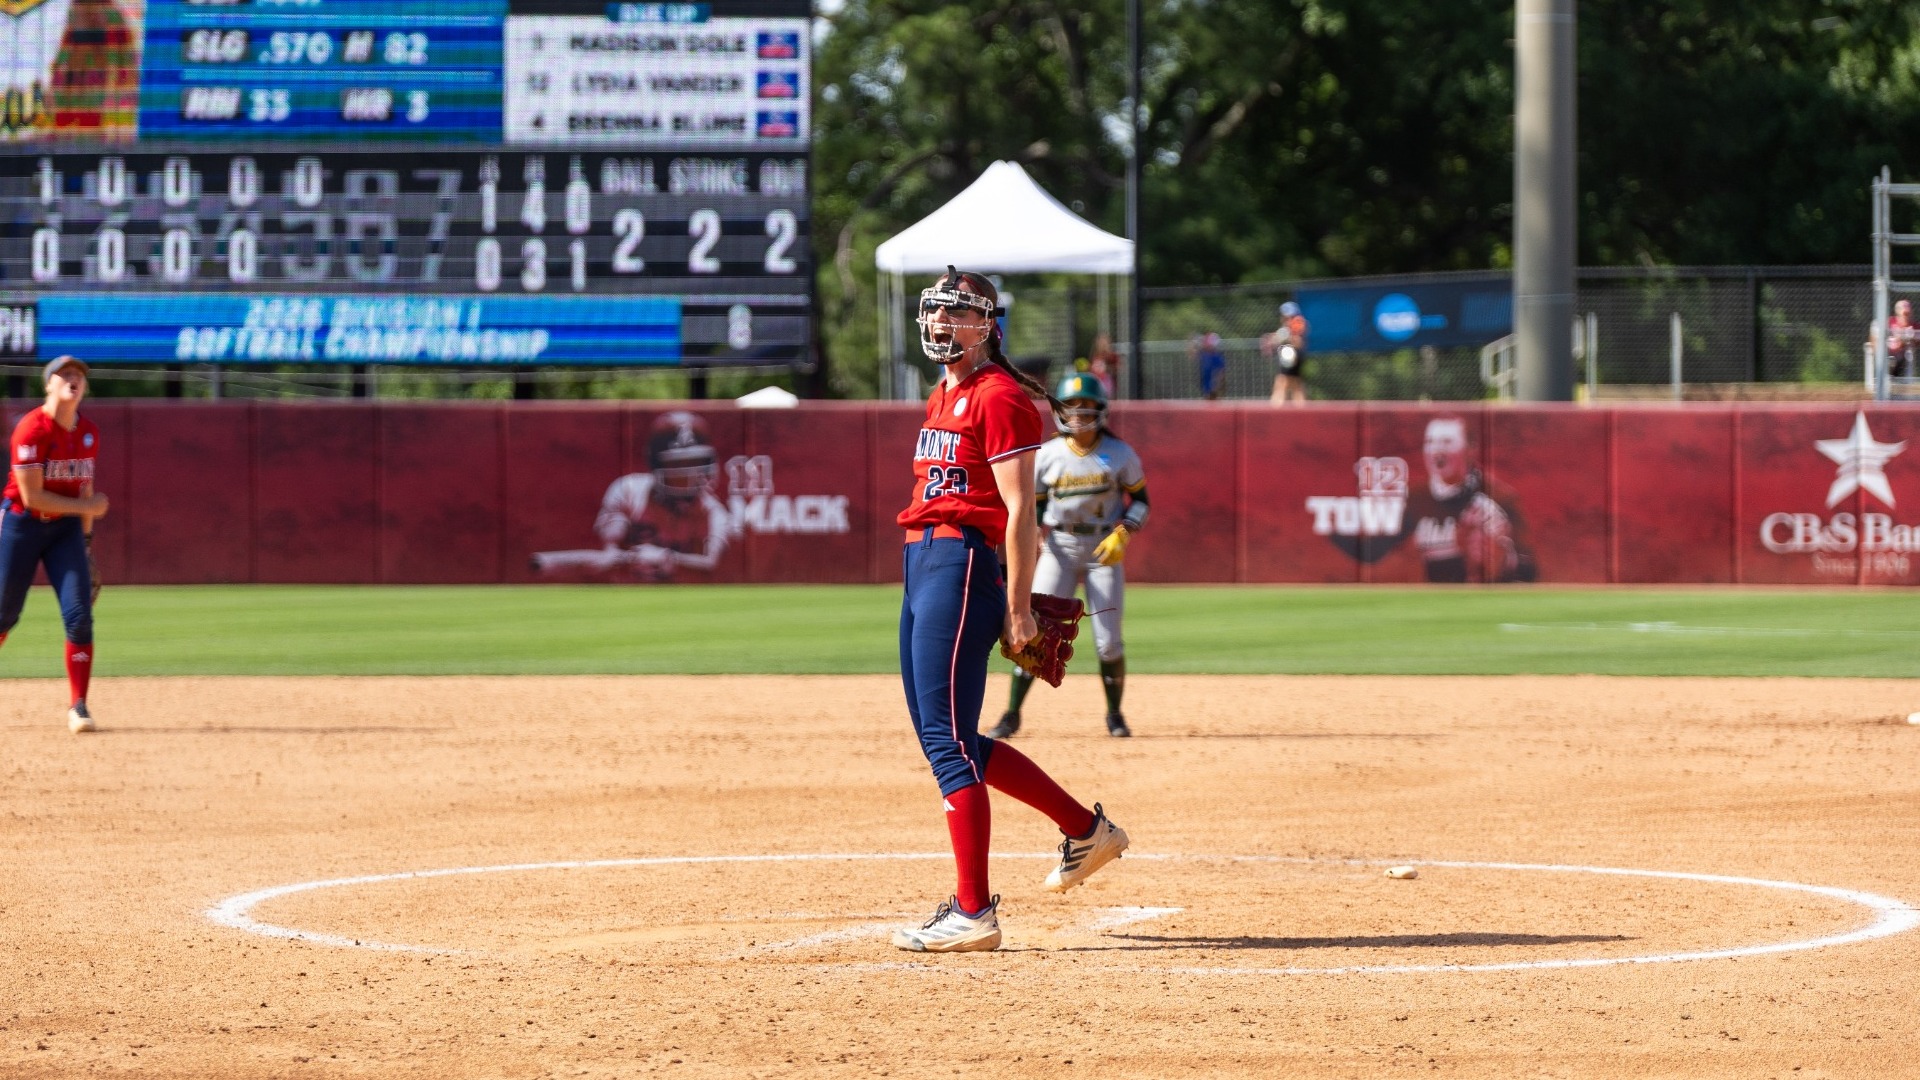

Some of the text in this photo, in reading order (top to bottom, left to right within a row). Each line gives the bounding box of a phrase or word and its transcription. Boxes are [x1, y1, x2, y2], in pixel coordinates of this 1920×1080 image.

[186, 31, 332, 64] SLG .570
[345, 32, 428, 65] H 82
[571, 34, 677, 51] MADISON
[574, 74, 637, 92] LYDIA
[186, 88, 241, 120] RBI
[568, 113, 661, 131] BRENNA
[674, 113, 747, 131] BLUME
[38, 157, 322, 206] 1 0 0 0 0
[600, 158, 807, 195] BALL STRIKE OUT
[481, 180, 591, 234] 1 4 0
[32, 229, 257, 283] 0 0 0 0
[612, 209, 797, 273] 2 2 2
[475, 238, 587, 292] 0 3 1
[331, 300, 461, 328] DIVISION
[176, 328, 549, 361] SOFTBALL CHAMPIONSHIP
[726, 456, 772, 494] 11
[923, 466, 968, 501] 23
[1356, 457, 1408, 497] 12
[730, 496, 848, 534] MACK
[1306, 496, 1403, 535] TOW
